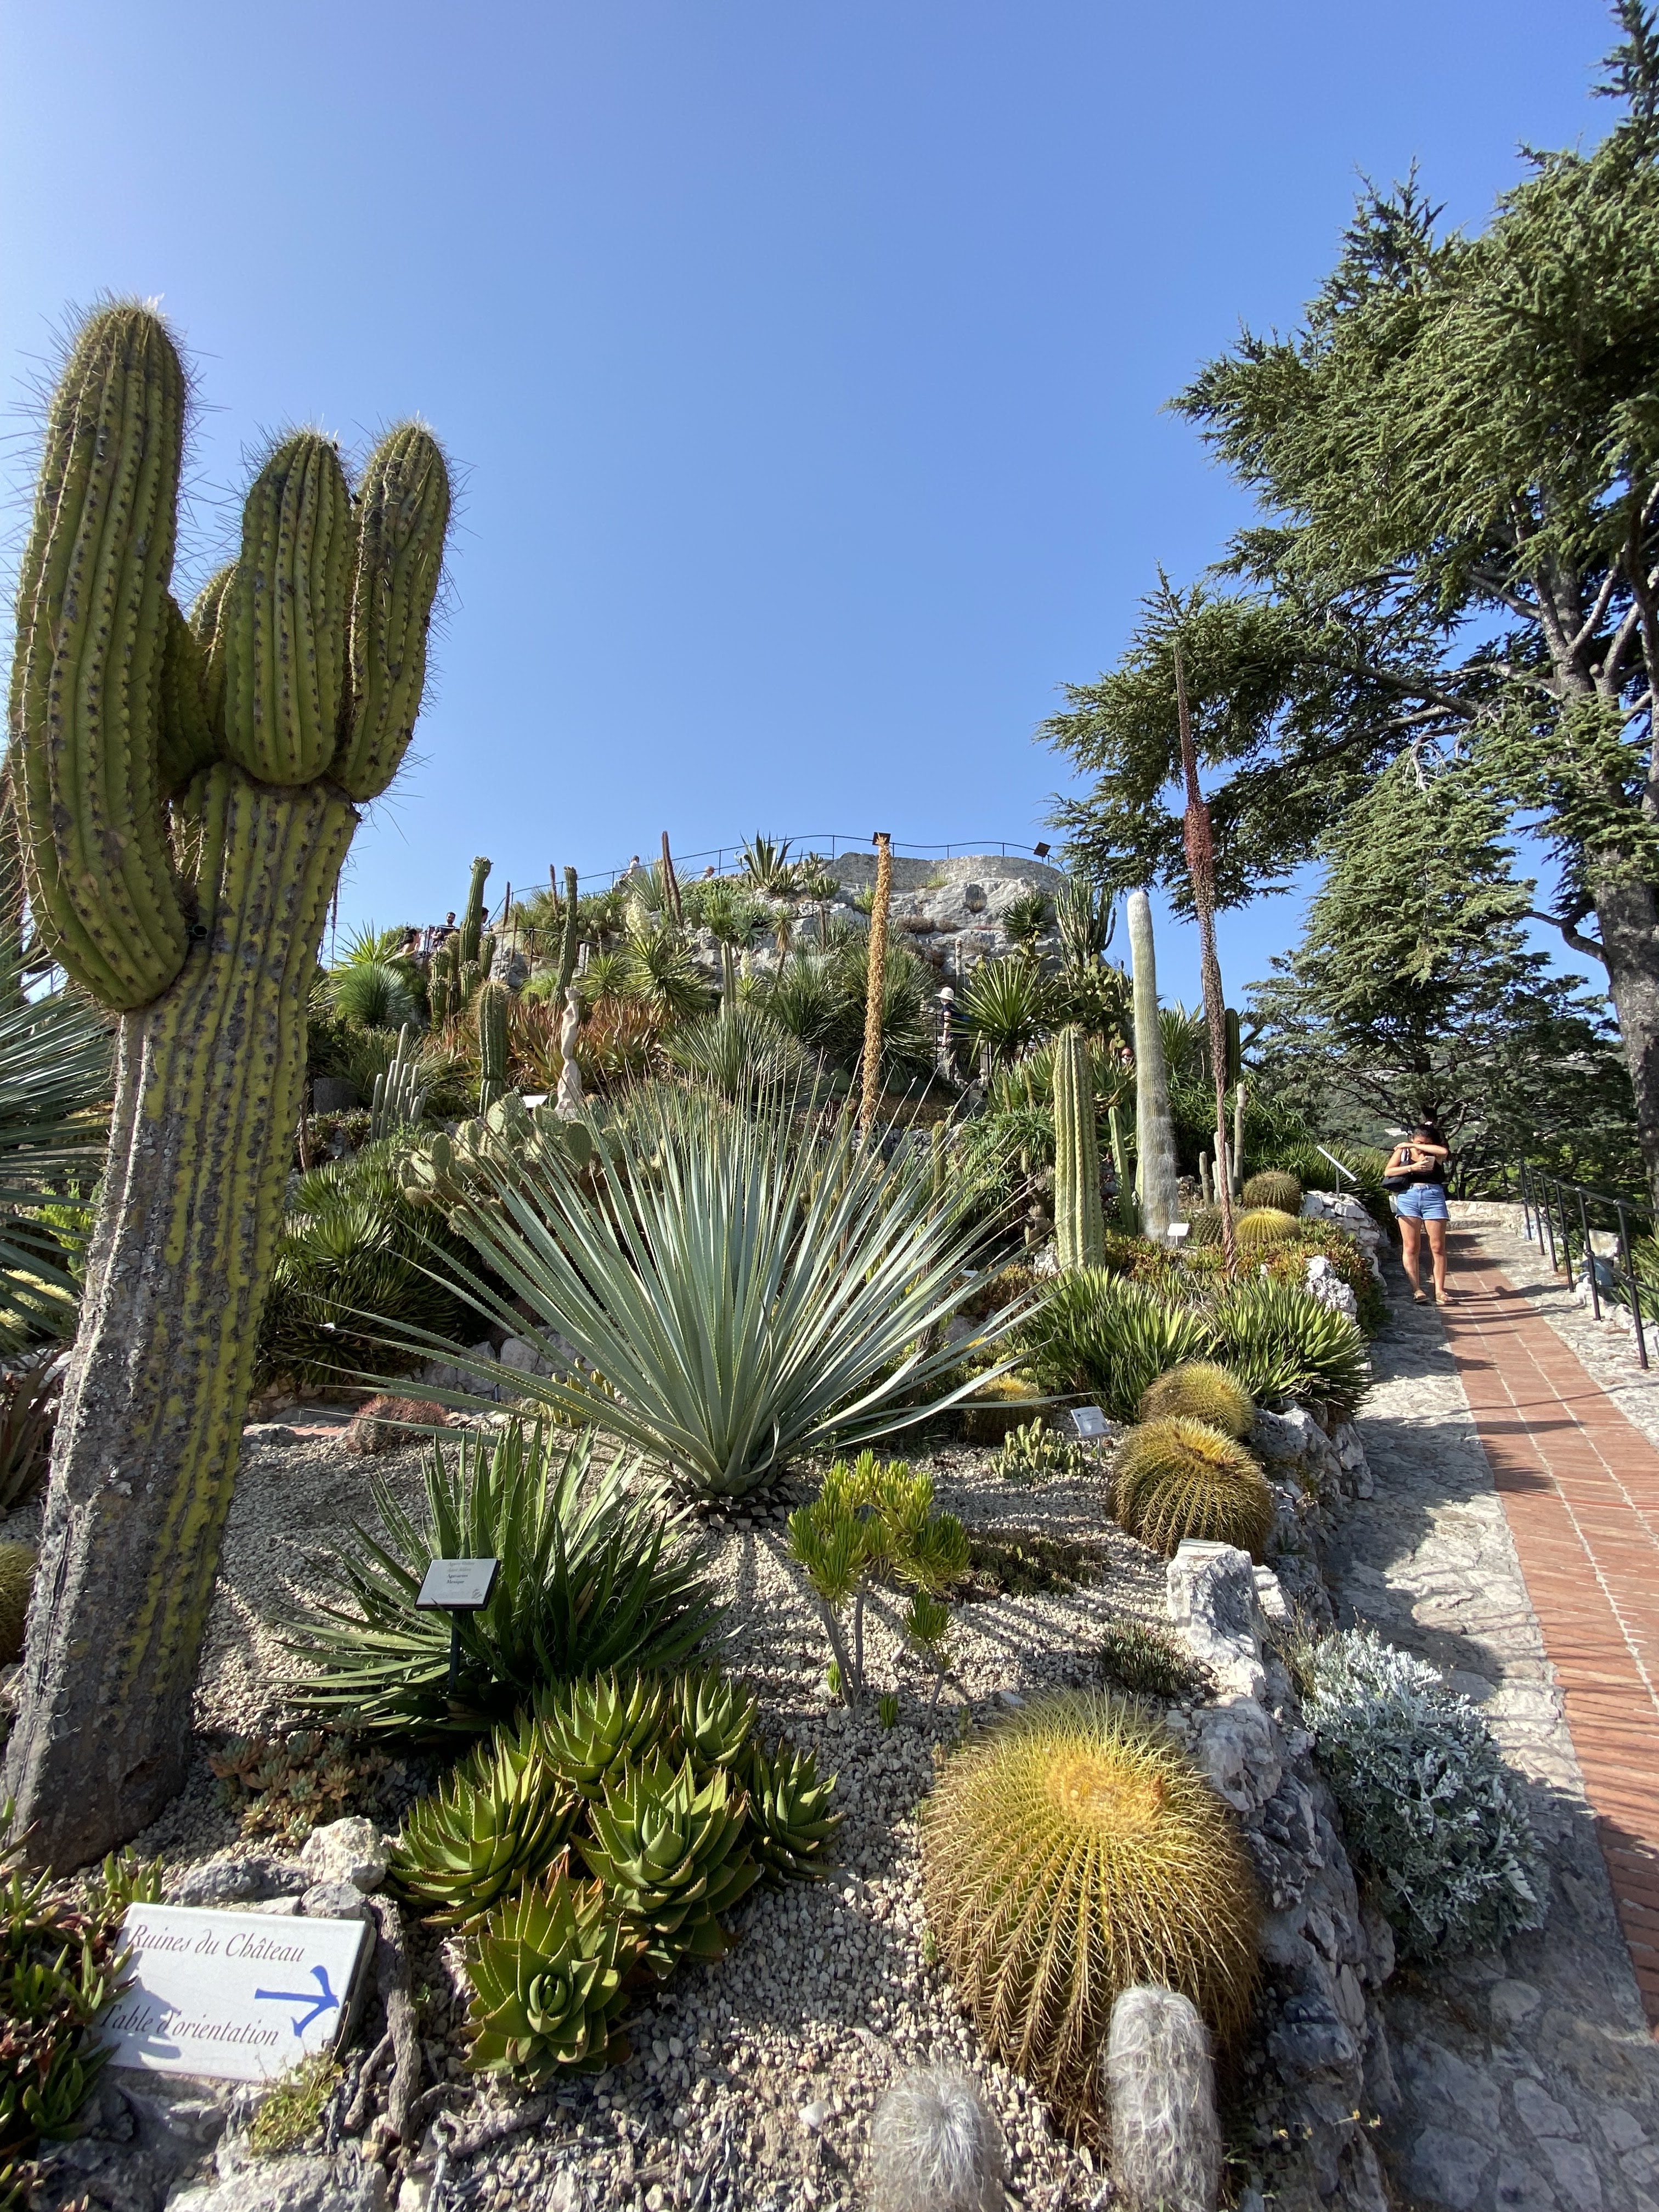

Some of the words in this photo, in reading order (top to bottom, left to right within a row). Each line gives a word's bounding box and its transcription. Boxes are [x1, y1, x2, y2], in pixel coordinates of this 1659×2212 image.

[128, 1923, 192, 1952] Ruines
[195, 1928, 219, 1955] du
[225, 1932, 304, 1962] Château
[99, 2004, 154, 2033] Table
[156, 2008, 279, 2046] d'orientation
